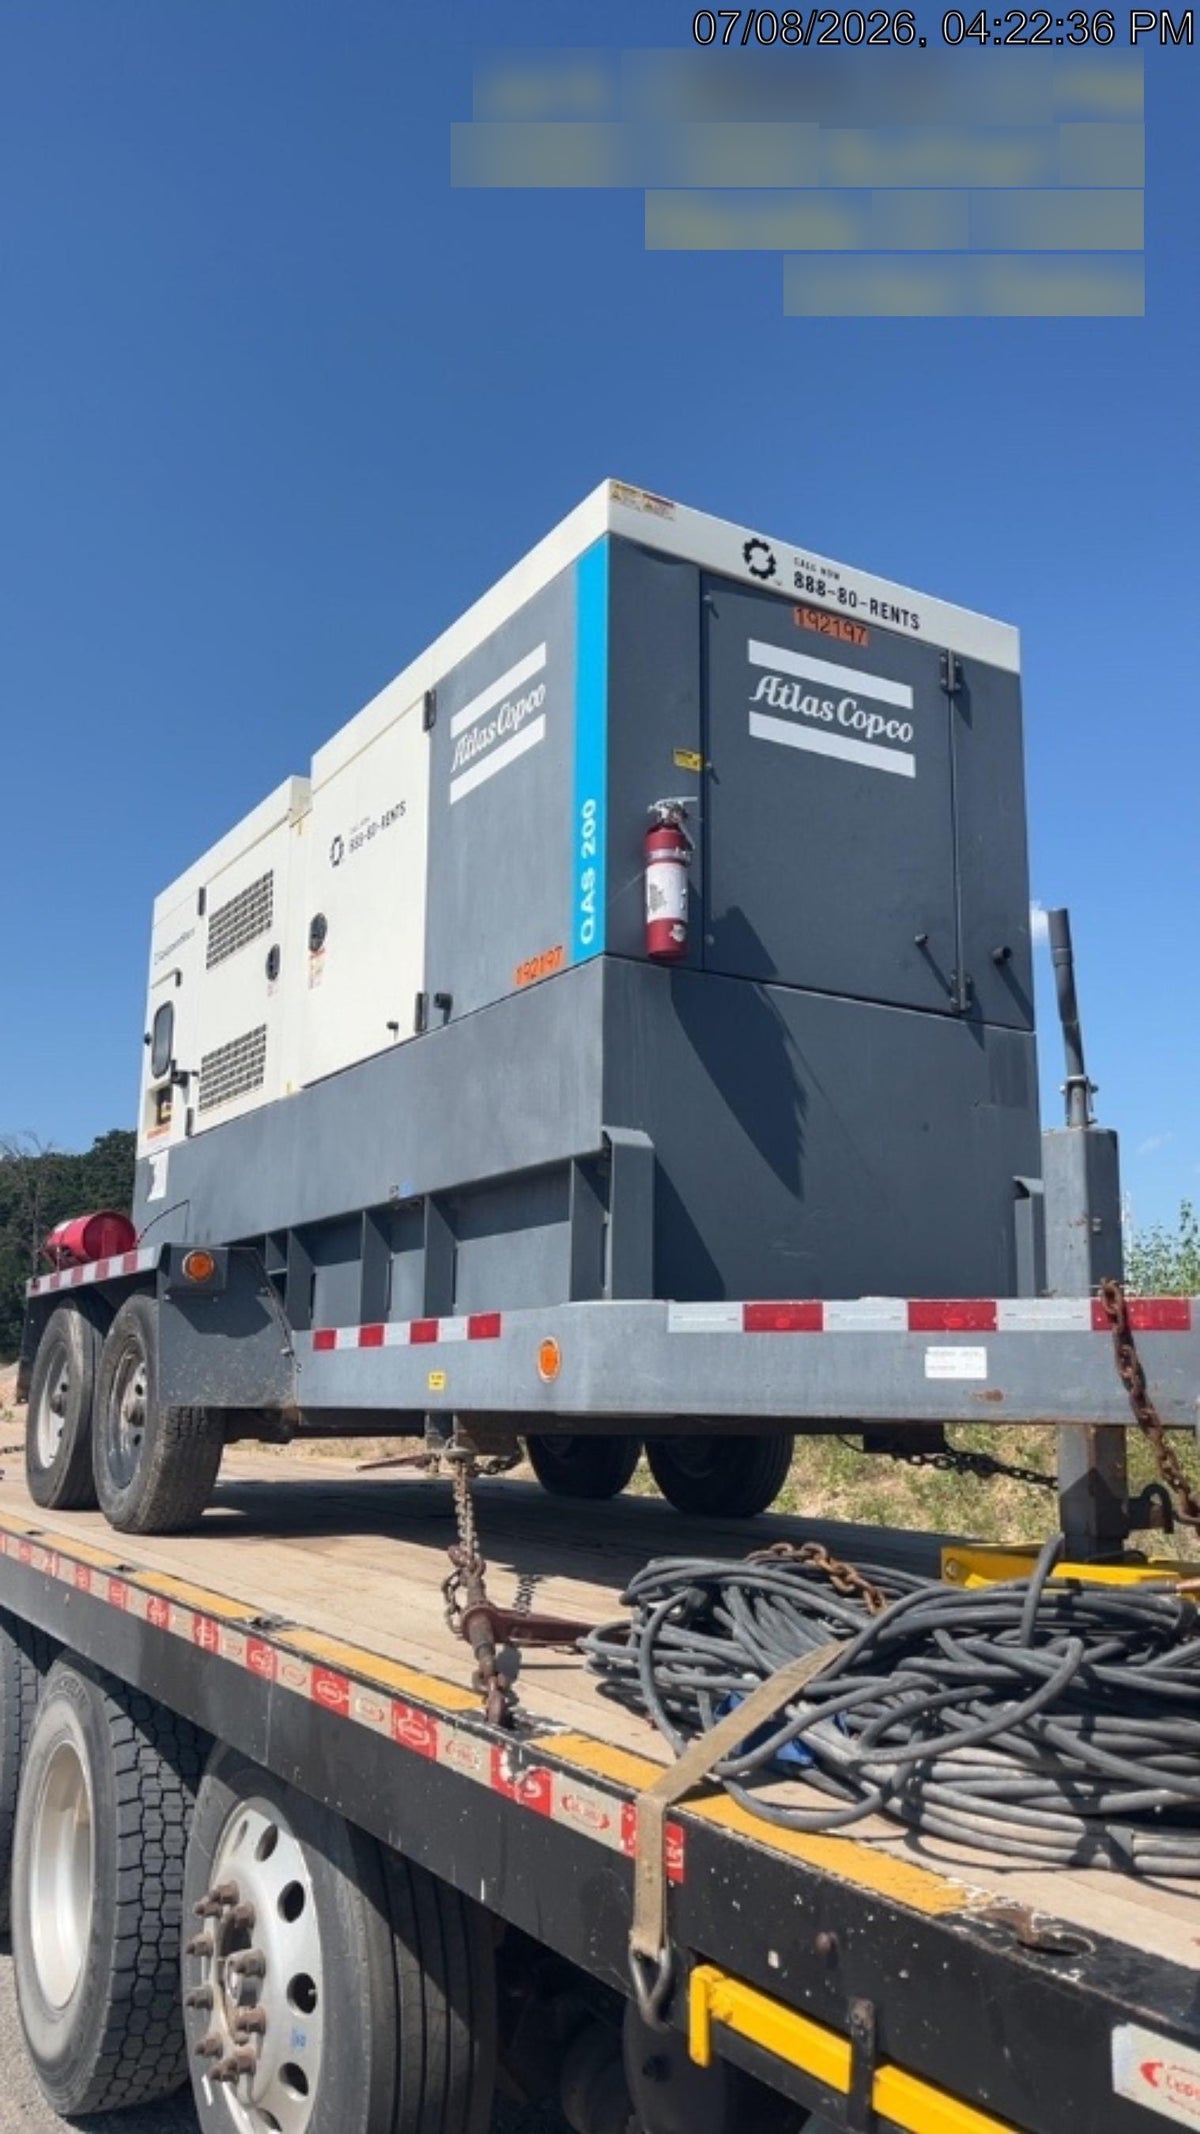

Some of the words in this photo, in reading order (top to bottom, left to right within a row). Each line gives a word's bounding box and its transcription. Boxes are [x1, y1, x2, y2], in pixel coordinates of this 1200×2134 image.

[793, 570, 920, 631] 888-80-RENTS
[795, 608, 867, 644] 192197
[451, 721, 497, 773] Atlas
[497, 683, 546, 736] Copco
[749, 674, 835, 722] Atlas
[837, 697, 914, 742] Copco
[581, 798, 597, 859] 200
[580, 867, 596, 945] QAS
